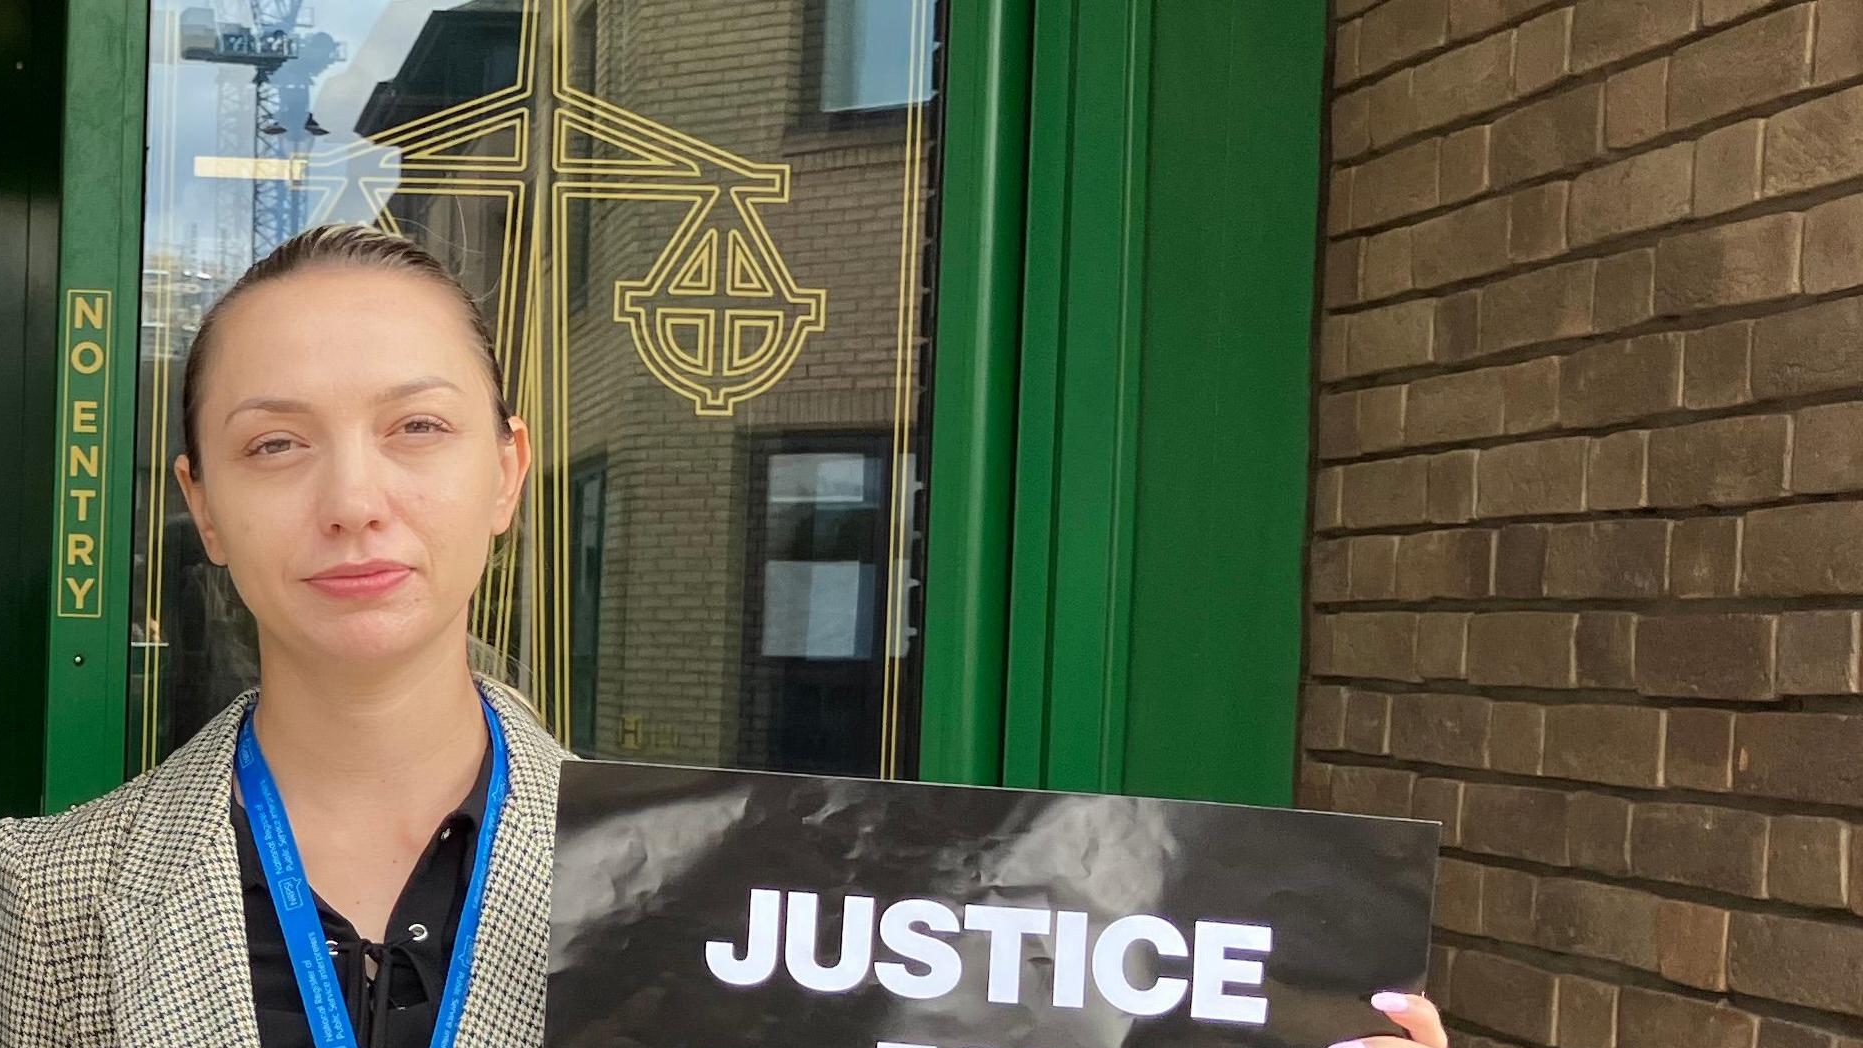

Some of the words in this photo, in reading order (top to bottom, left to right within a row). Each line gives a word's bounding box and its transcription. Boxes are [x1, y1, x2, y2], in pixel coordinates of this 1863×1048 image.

[71, 297, 104, 374] NO
[65, 401, 98, 609] ENTRY
[704, 889, 1273, 1026] JUSTICE
